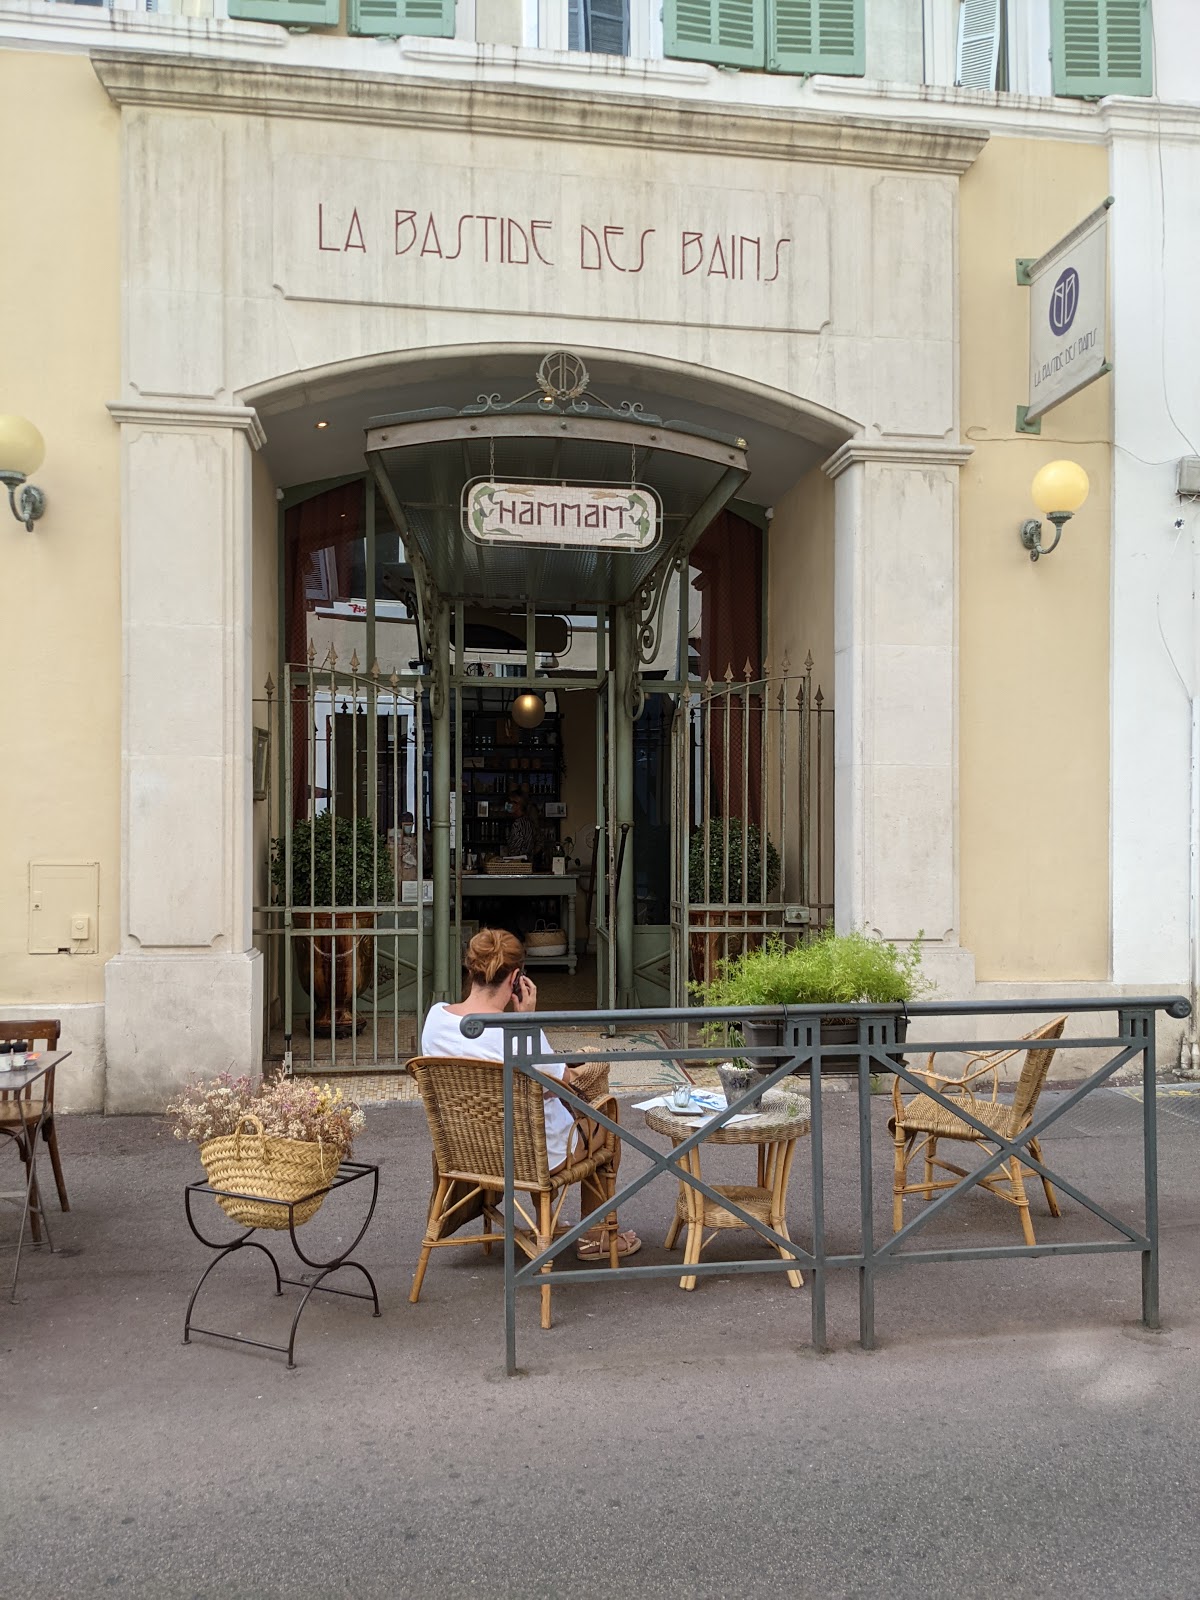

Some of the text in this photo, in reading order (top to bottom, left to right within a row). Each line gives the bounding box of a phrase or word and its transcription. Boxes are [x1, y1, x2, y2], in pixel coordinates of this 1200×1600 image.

[318, 203, 791, 282] LA BASTIDE DES BAINS
[1034, 327, 1098, 388] LA BASTIDE DES BAINS
